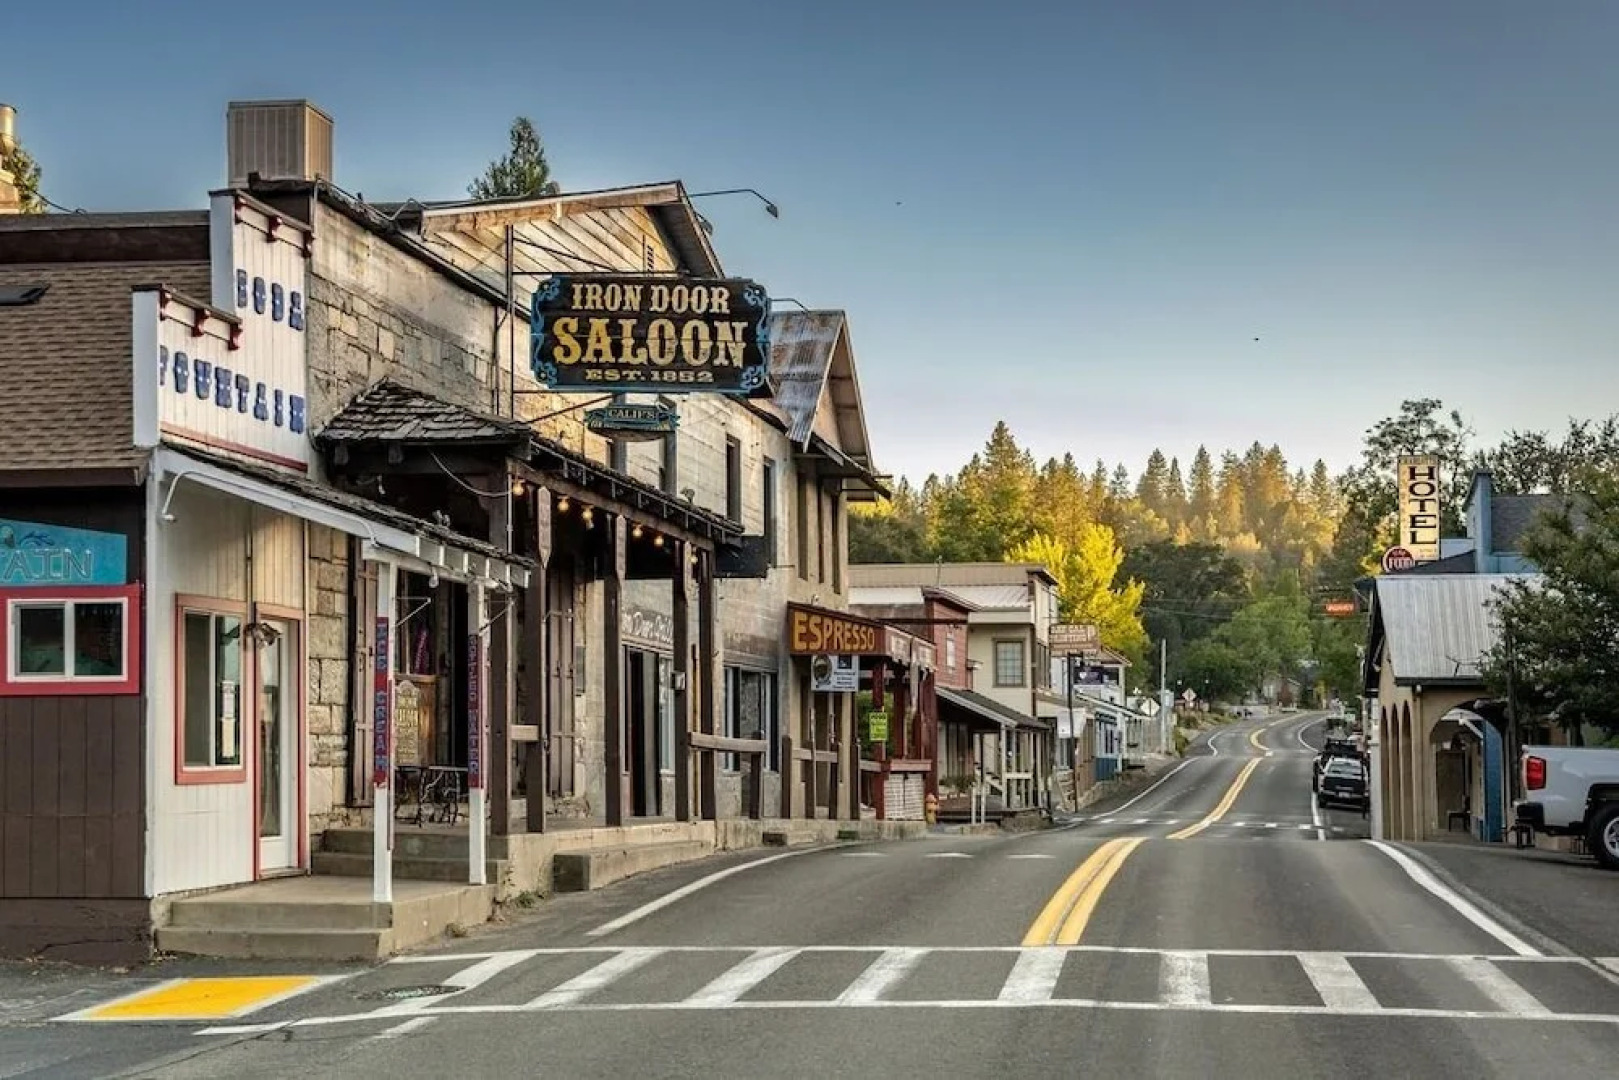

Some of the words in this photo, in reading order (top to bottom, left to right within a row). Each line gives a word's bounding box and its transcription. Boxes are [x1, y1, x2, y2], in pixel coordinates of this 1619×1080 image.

[571, 283, 643, 312] IRON
[650, 284, 730, 314] DOOR
[553, 316, 748, 368] SALOON
[1408, 466, 1437, 544] HOTEL
[0, 548, 93, 581] AIN
[795, 611, 875, 650] ESPRESSO
